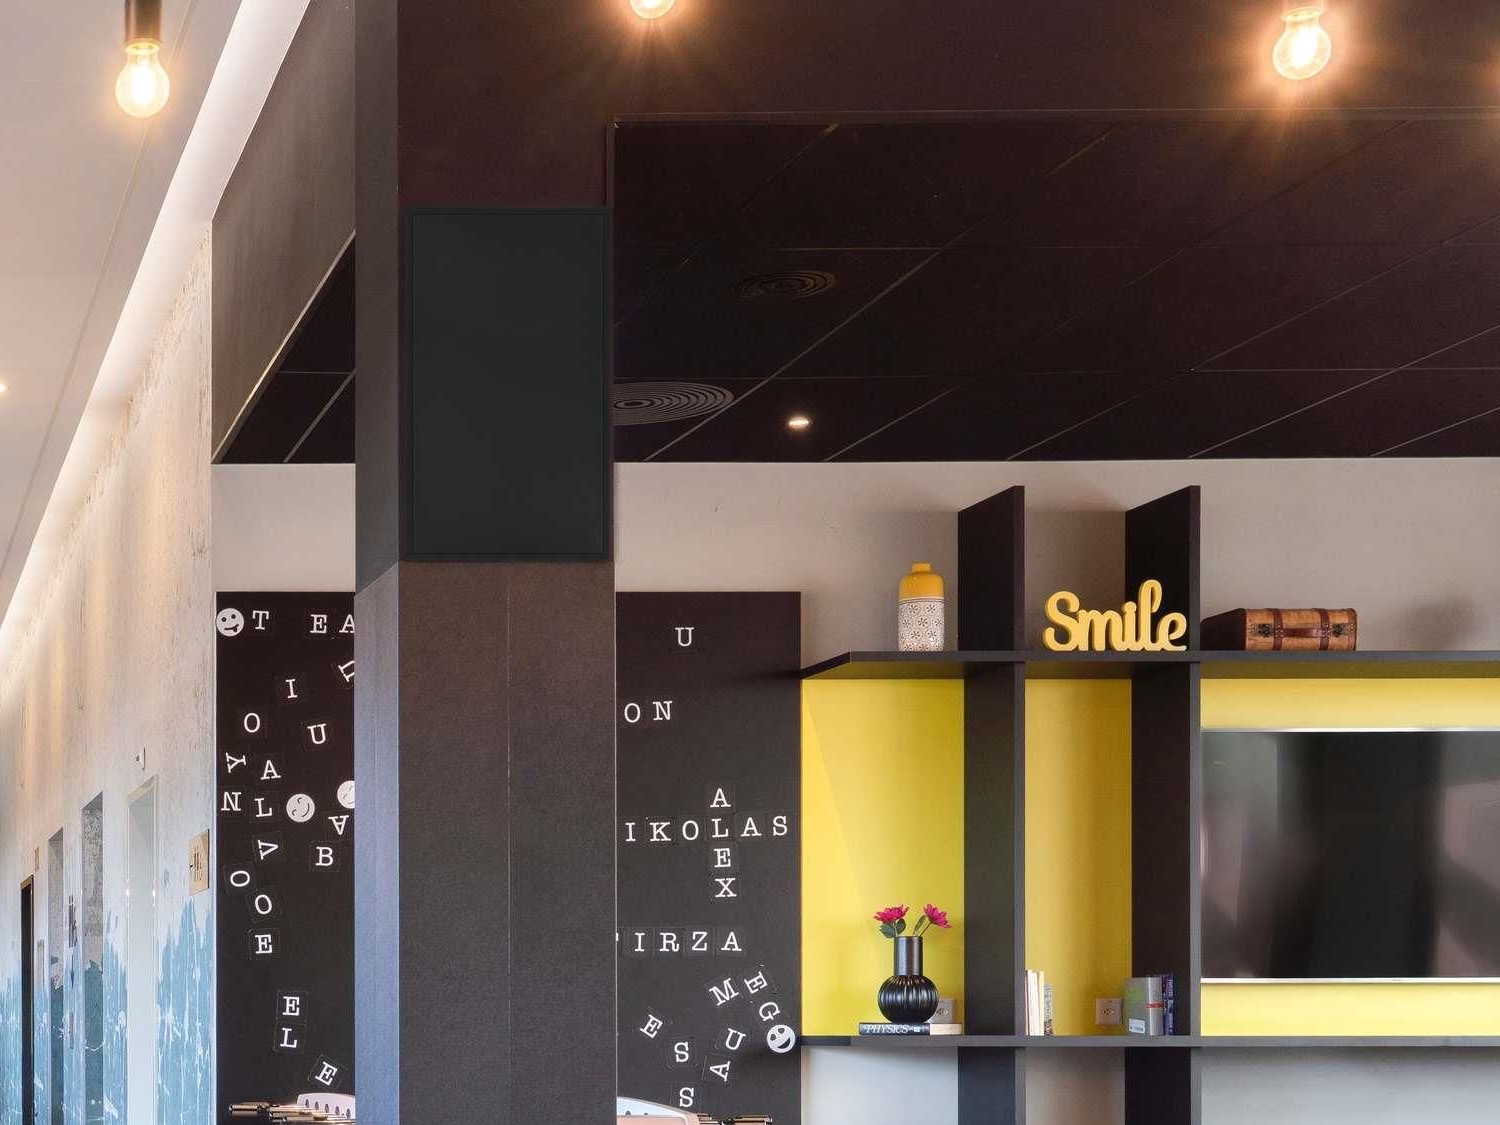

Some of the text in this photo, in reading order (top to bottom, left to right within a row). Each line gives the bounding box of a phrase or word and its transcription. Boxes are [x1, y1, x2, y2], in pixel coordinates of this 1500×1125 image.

[1043, 579, 1187, 651] Smile
[674, 626, 695, 647] U
[616, 930, 743, 953] IRZA
